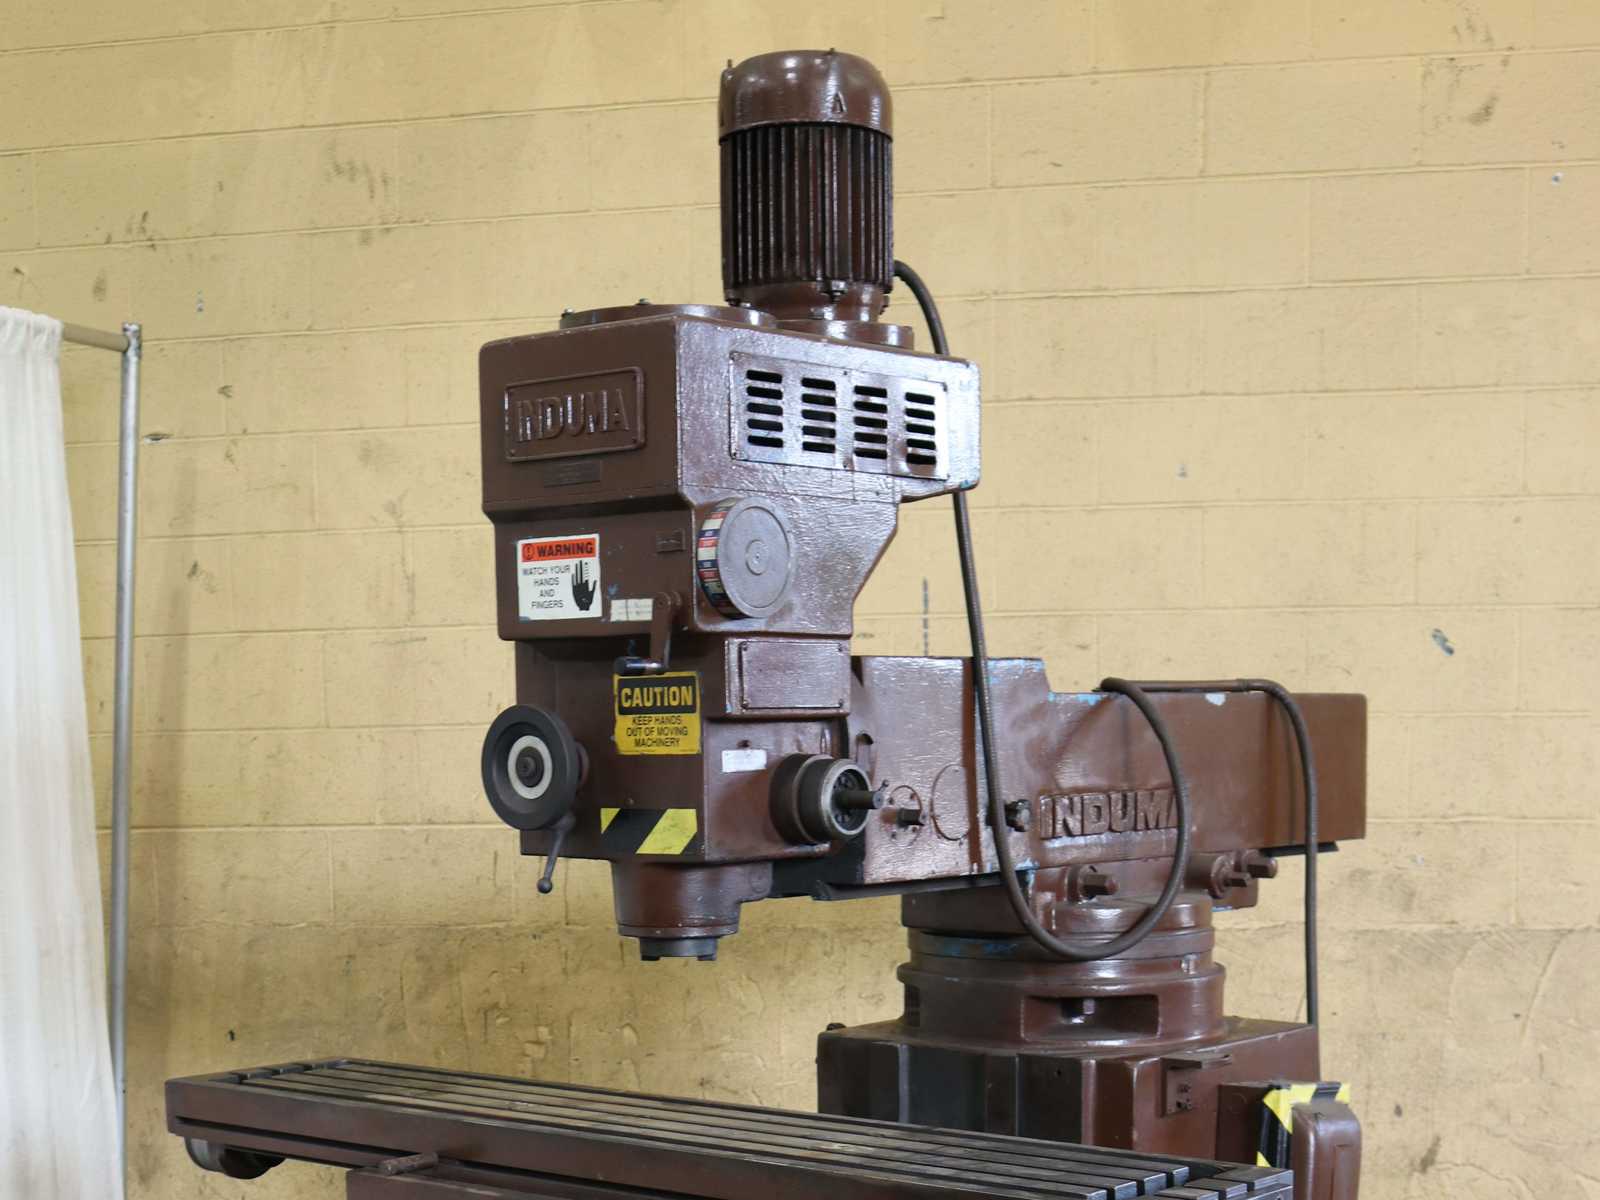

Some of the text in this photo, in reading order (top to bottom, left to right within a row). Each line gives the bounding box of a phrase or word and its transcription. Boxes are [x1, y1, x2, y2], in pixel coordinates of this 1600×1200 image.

[537, 542, 593, 557] WARNING
[523, 565, 571, 576] WATCH YOUR
[534, 577, 559, 586] HANDS
[539, 589, 555, 597] AND
[531, 600, 564, 608] FINGERS
[621, 685, 693, 708] CAUTION
[632, 715, 682, 725] KEEP HANDS
[626, 726, 688, 736] OUT OF MOVING
[634, 737, 680, 747] MACHINERY
